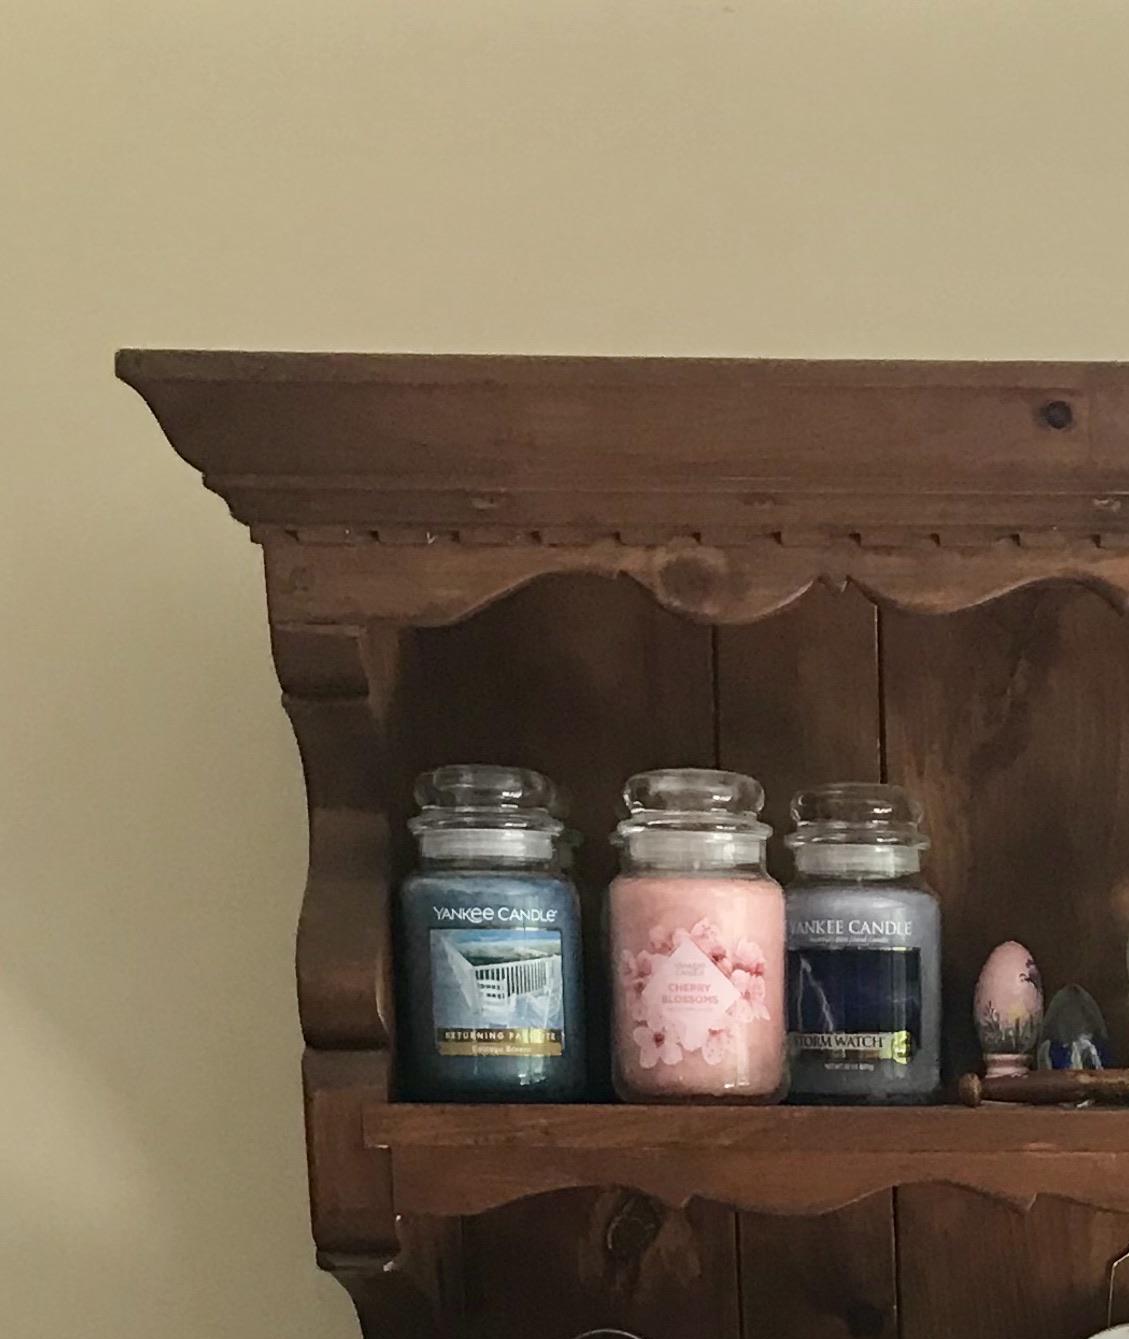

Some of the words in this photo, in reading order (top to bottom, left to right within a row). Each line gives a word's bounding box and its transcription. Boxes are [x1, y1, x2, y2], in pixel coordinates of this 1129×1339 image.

[433, 906, 495, 924] YANKEE
[498, 906, 557, 922] CANDLE
[848, 919, 912, 936] CANDLE
[668, 984, 711, 993] CHERRY
[662, 995, 719, 1005] BLOSSOMS
[835, 1034, 884, 1048] WATCH
